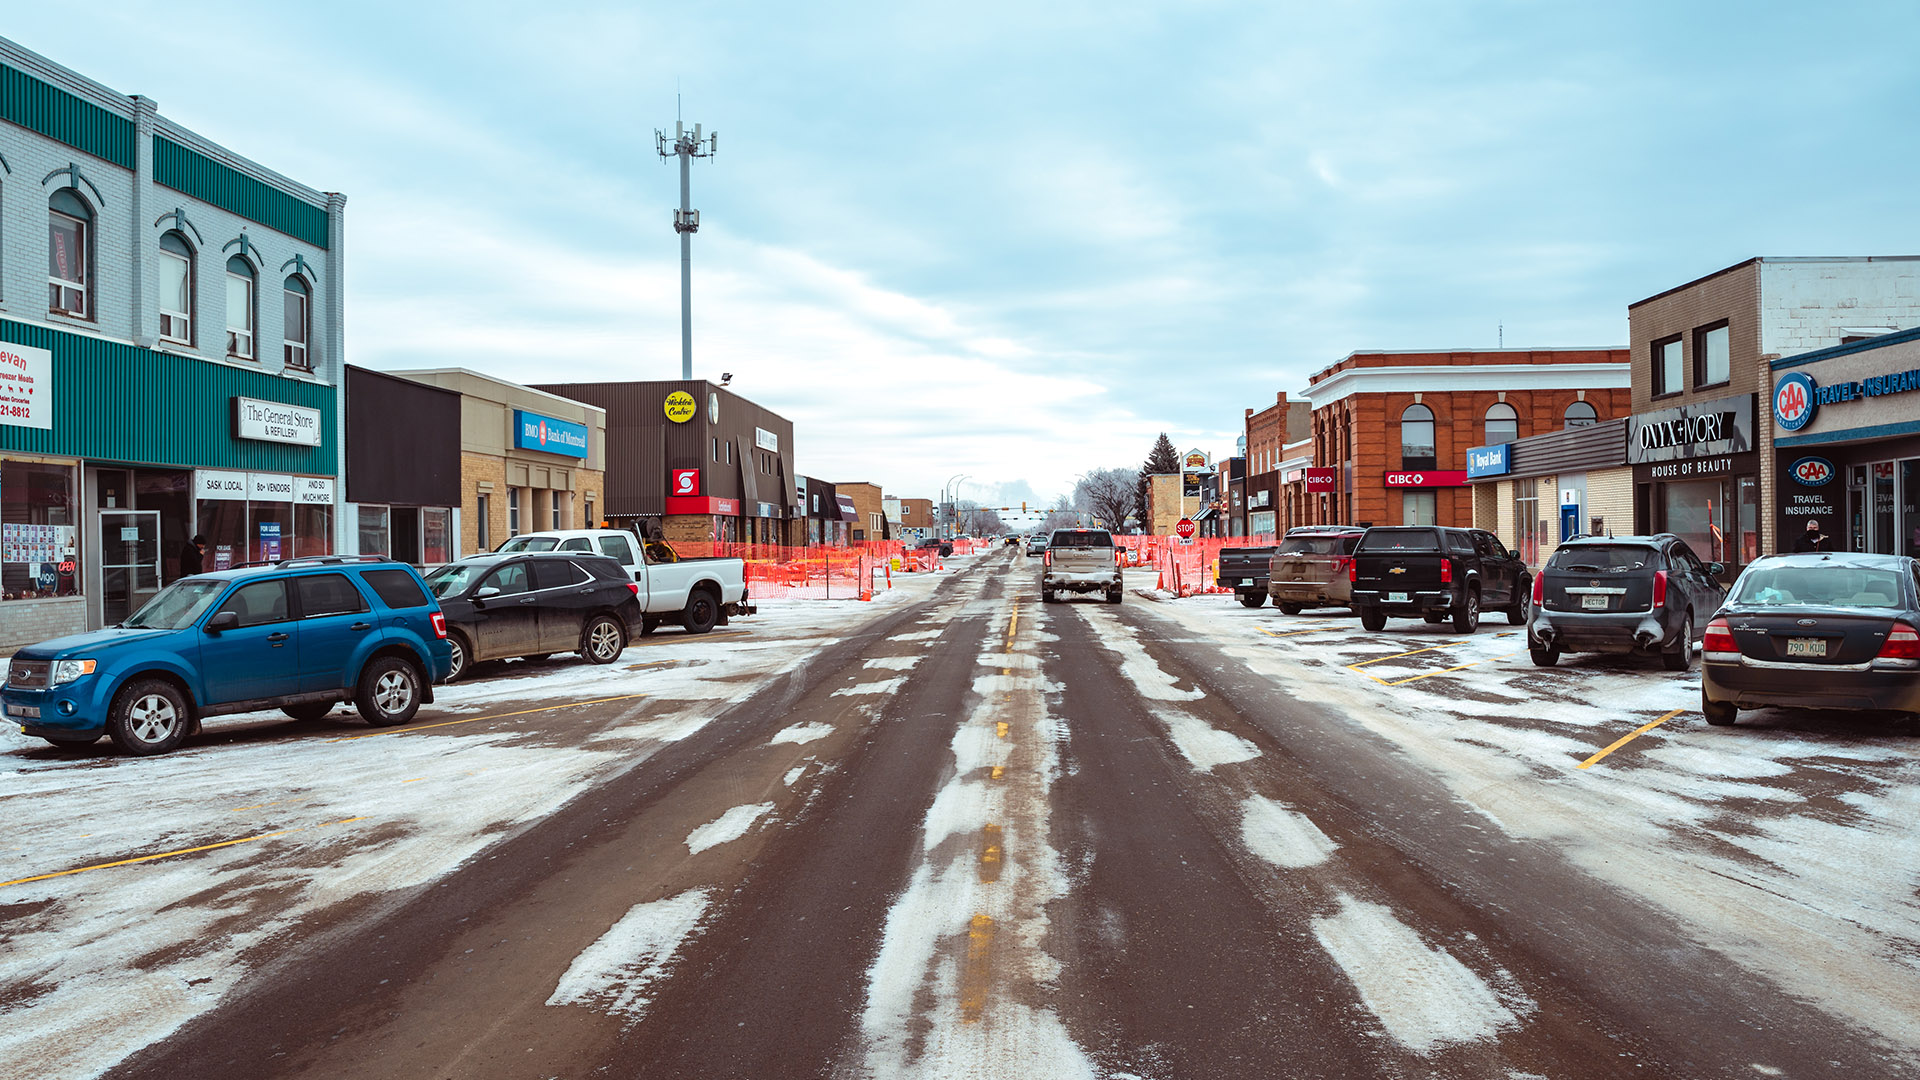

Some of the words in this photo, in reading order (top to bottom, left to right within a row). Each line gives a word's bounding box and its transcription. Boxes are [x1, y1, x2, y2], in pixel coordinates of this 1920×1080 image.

[17, 373, 34, 384] Meats
[1815, 381, 1855, 406] TRAVEL
[1779, 383, 1805, 419] CAA
[247, 404, 263, 422] The
[264, 407, 293, 426] General
[294, 412, 313, 429] Store
[265, 425, 269, 436] &
[270, 426, 298, 438] REFILLERY
[525, 423, 539, 439] BMO
[547, 427, 561, 443] Bank
[560, 431, 566, 443] of
[565, 431, 586, 448] Montreal
[1476, 451, 1490, 470] Royal
[1490, 449, 1502, 466] Bank
[1651, 464, 1677, 478] HOUSE
[1681, 462, 1692, 475] OF
[1697, 458, 1732, 473] BEAUTY
[1798, 462, 1827, 480] CAA
[308, 481, 318, 489] AND
[318, 481, 325, 489] SO
[1308, 476, 1325, 484] CIBC
[1388, 474, 1413, 485] CIBC
[206, 480, 223, 490] SASK
[224, 481, 243, 491] LOCAL
[266, 483, 291, 493] VENDORS
[302, 493, 317, 502] MUCH
[317, 494, 330, 503] MORE
[1793, 495, 1825, 504] TRAVEL
[1785, 505, 1833, 515] INSURANCE
[1177, 524, 1194, 533] STOP
[59, 561, 76, 572] OPEN
[1789, 642, 1804, 652] 790
